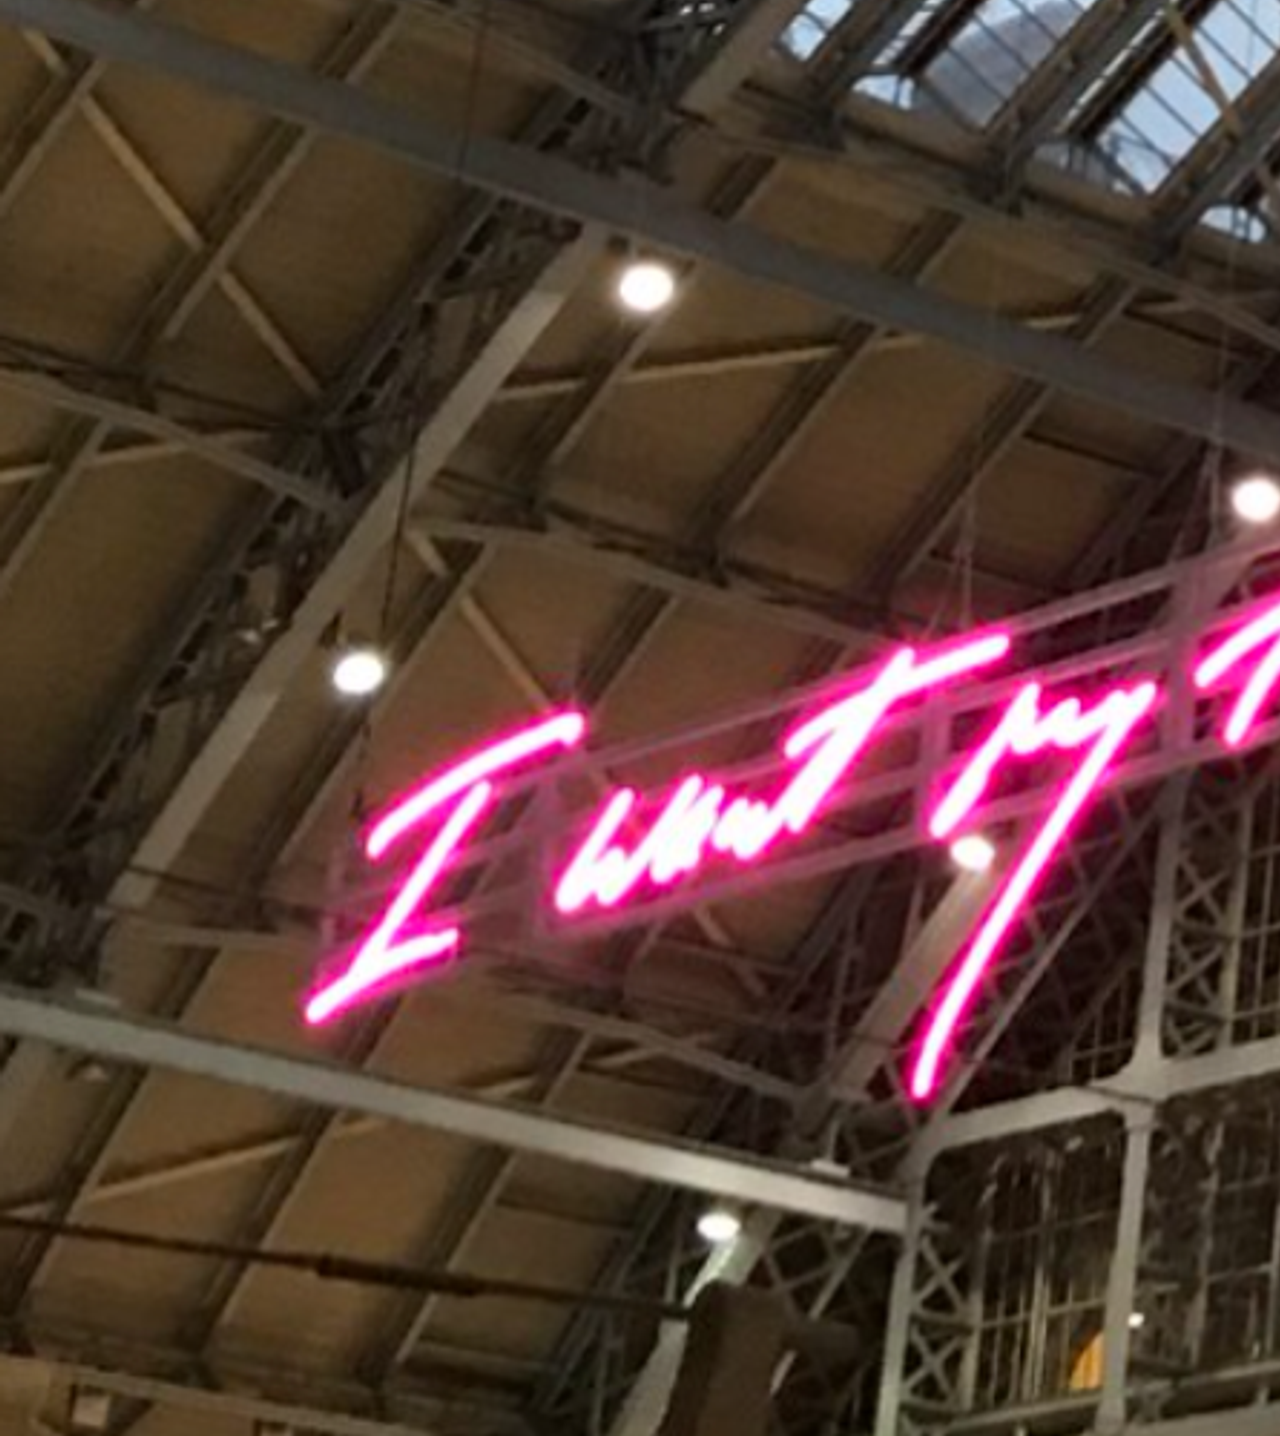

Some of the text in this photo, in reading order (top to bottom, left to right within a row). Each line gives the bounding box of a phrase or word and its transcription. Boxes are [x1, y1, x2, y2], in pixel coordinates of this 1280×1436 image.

[302, 707, 586, 1025] I
[550, 626, 1012, 916] want
[910, 678, 1162, 1102] my
